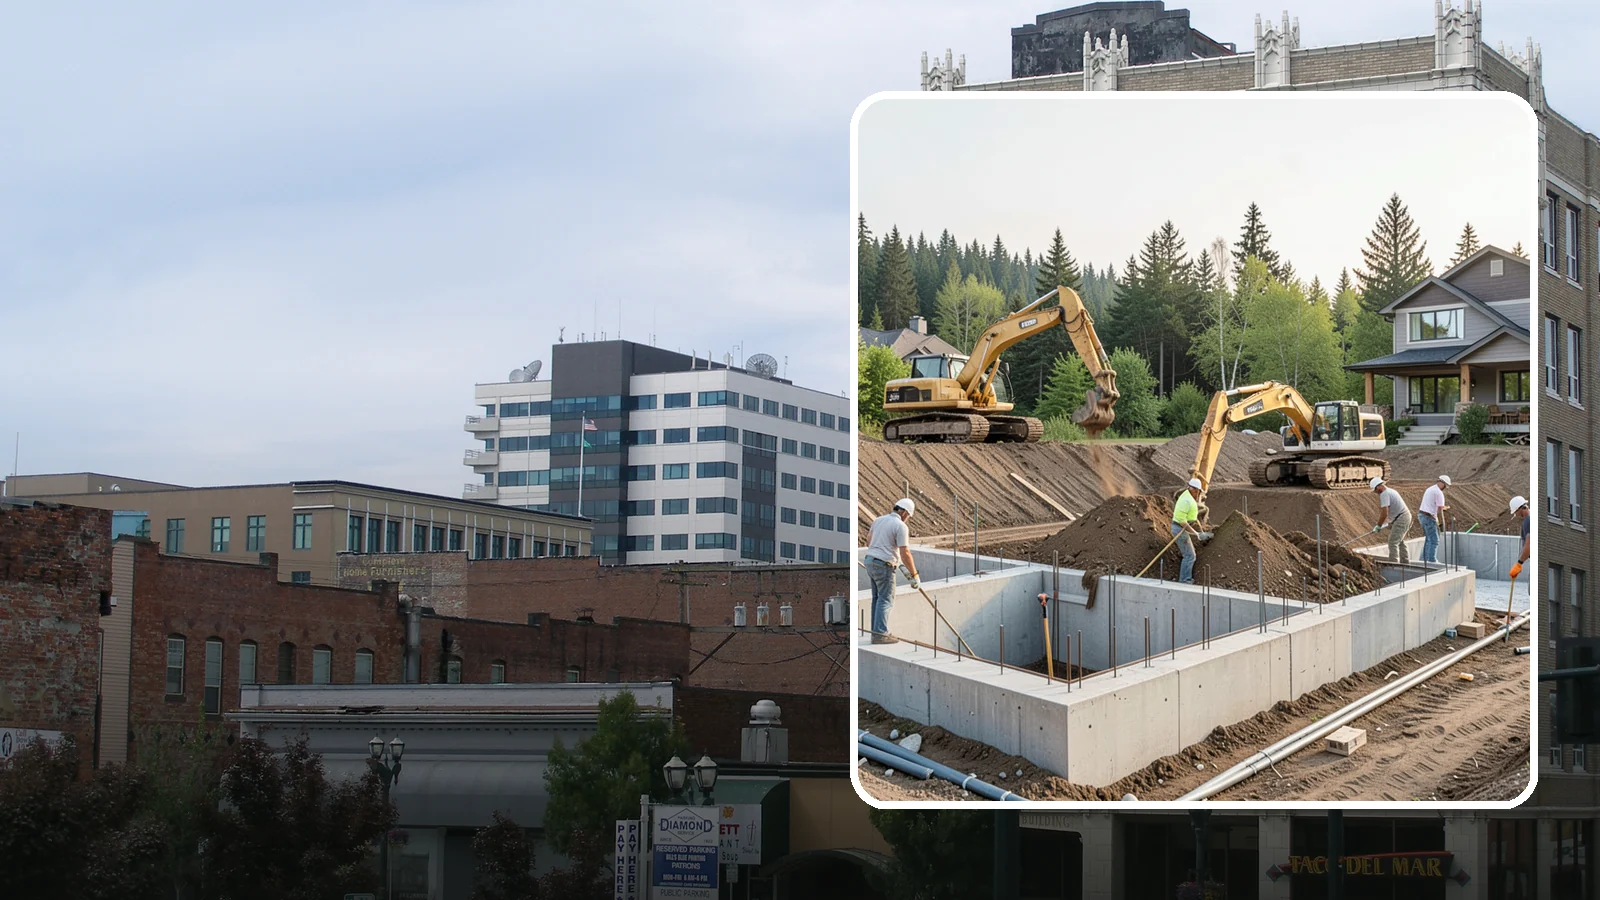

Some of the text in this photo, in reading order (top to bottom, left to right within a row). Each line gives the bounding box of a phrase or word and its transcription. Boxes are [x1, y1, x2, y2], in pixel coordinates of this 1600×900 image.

[370, 566, 427, 576] Furnishers
[660, 818, 713, 833] DIAMOND
[1022, 815, 1070, 828] BUILDING
[656, 845, 716, 854] RESERVED PARKING
[616, 825, 625, 893] PAY HERE
[627, 824, 637, 893] PAY HERE
[721, 851, 739, 862] Soup
[671, 862, 701, 870] PATRONS
[1289, 855, 1442, 876] TAC DEL MAR
[660, 888, 710, 898] PUBLIC PARKING
